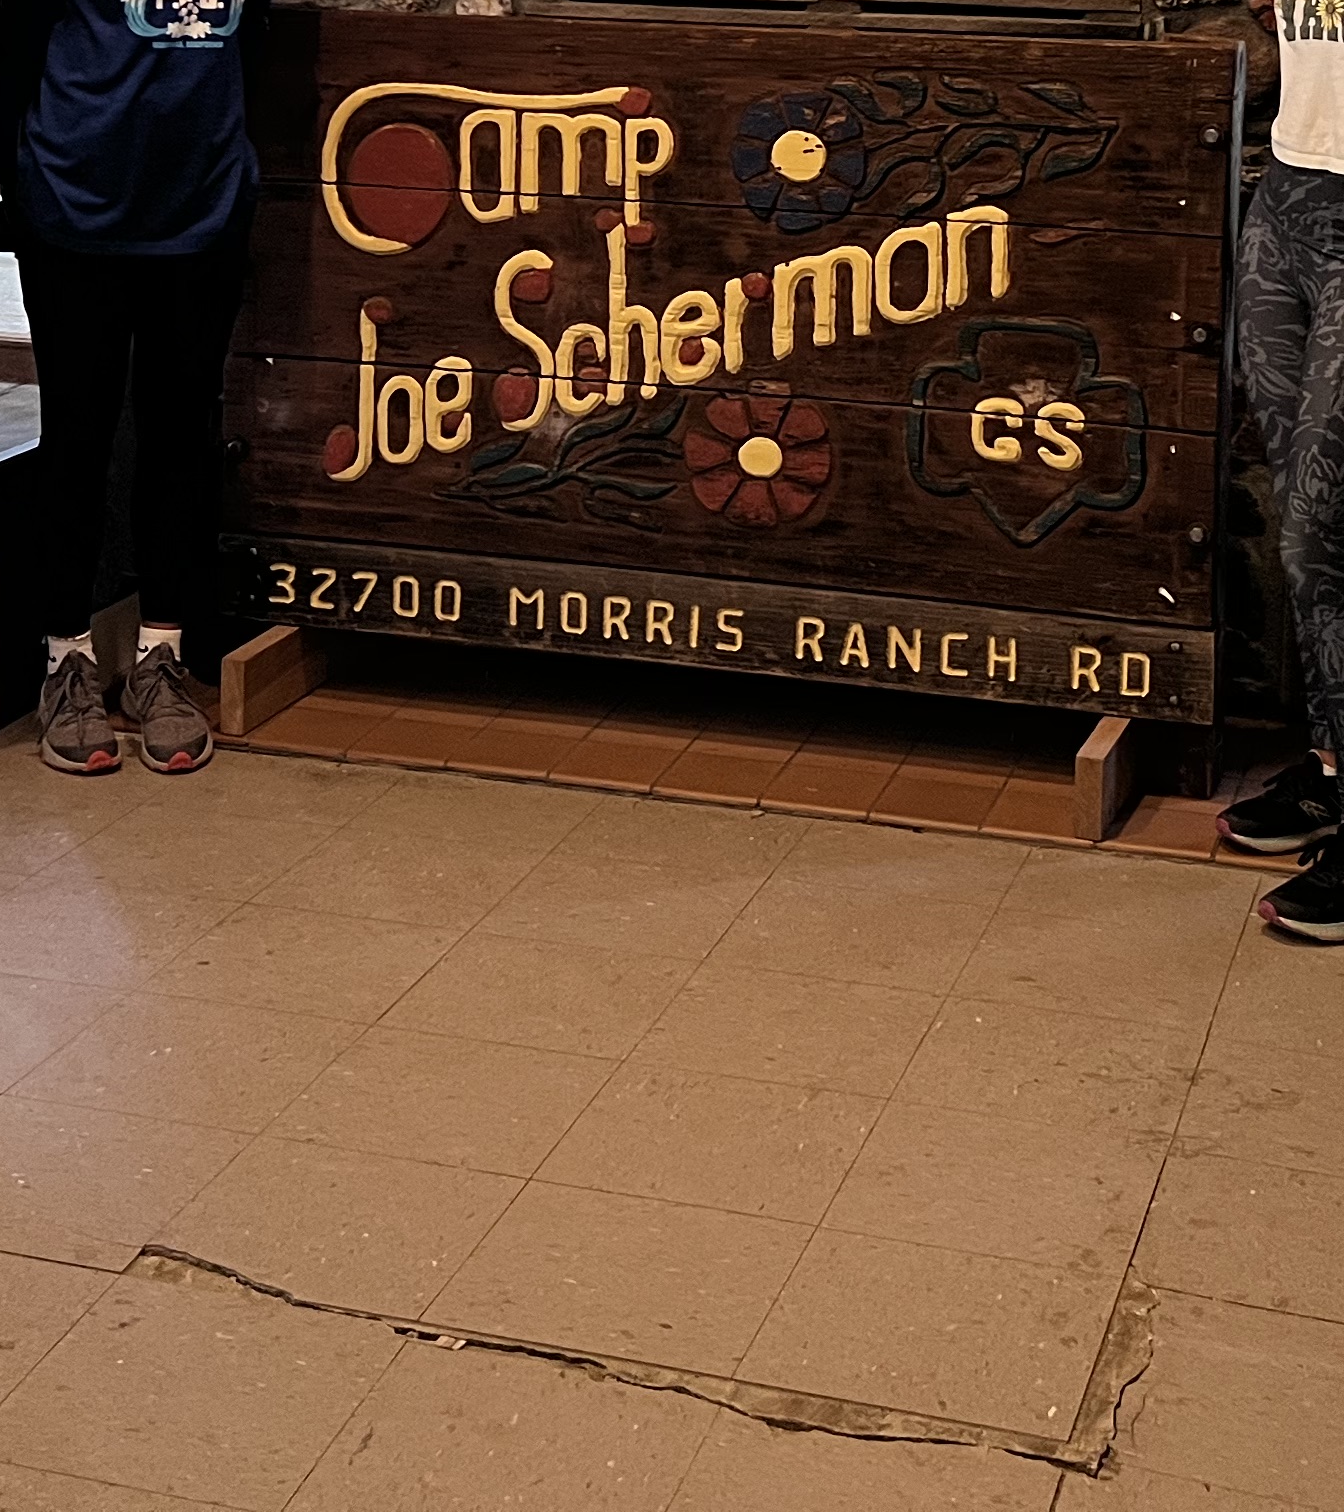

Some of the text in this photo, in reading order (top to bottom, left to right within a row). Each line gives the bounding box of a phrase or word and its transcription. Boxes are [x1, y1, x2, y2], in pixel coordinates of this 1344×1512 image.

[321, 82, 675, 256] Camp
[326, 204, 1010, 481] Joe Scherman
[970, 397, 1087, 472] GS
[267, 562, 1152, 700] 32700 MORRIS RANCH RD
